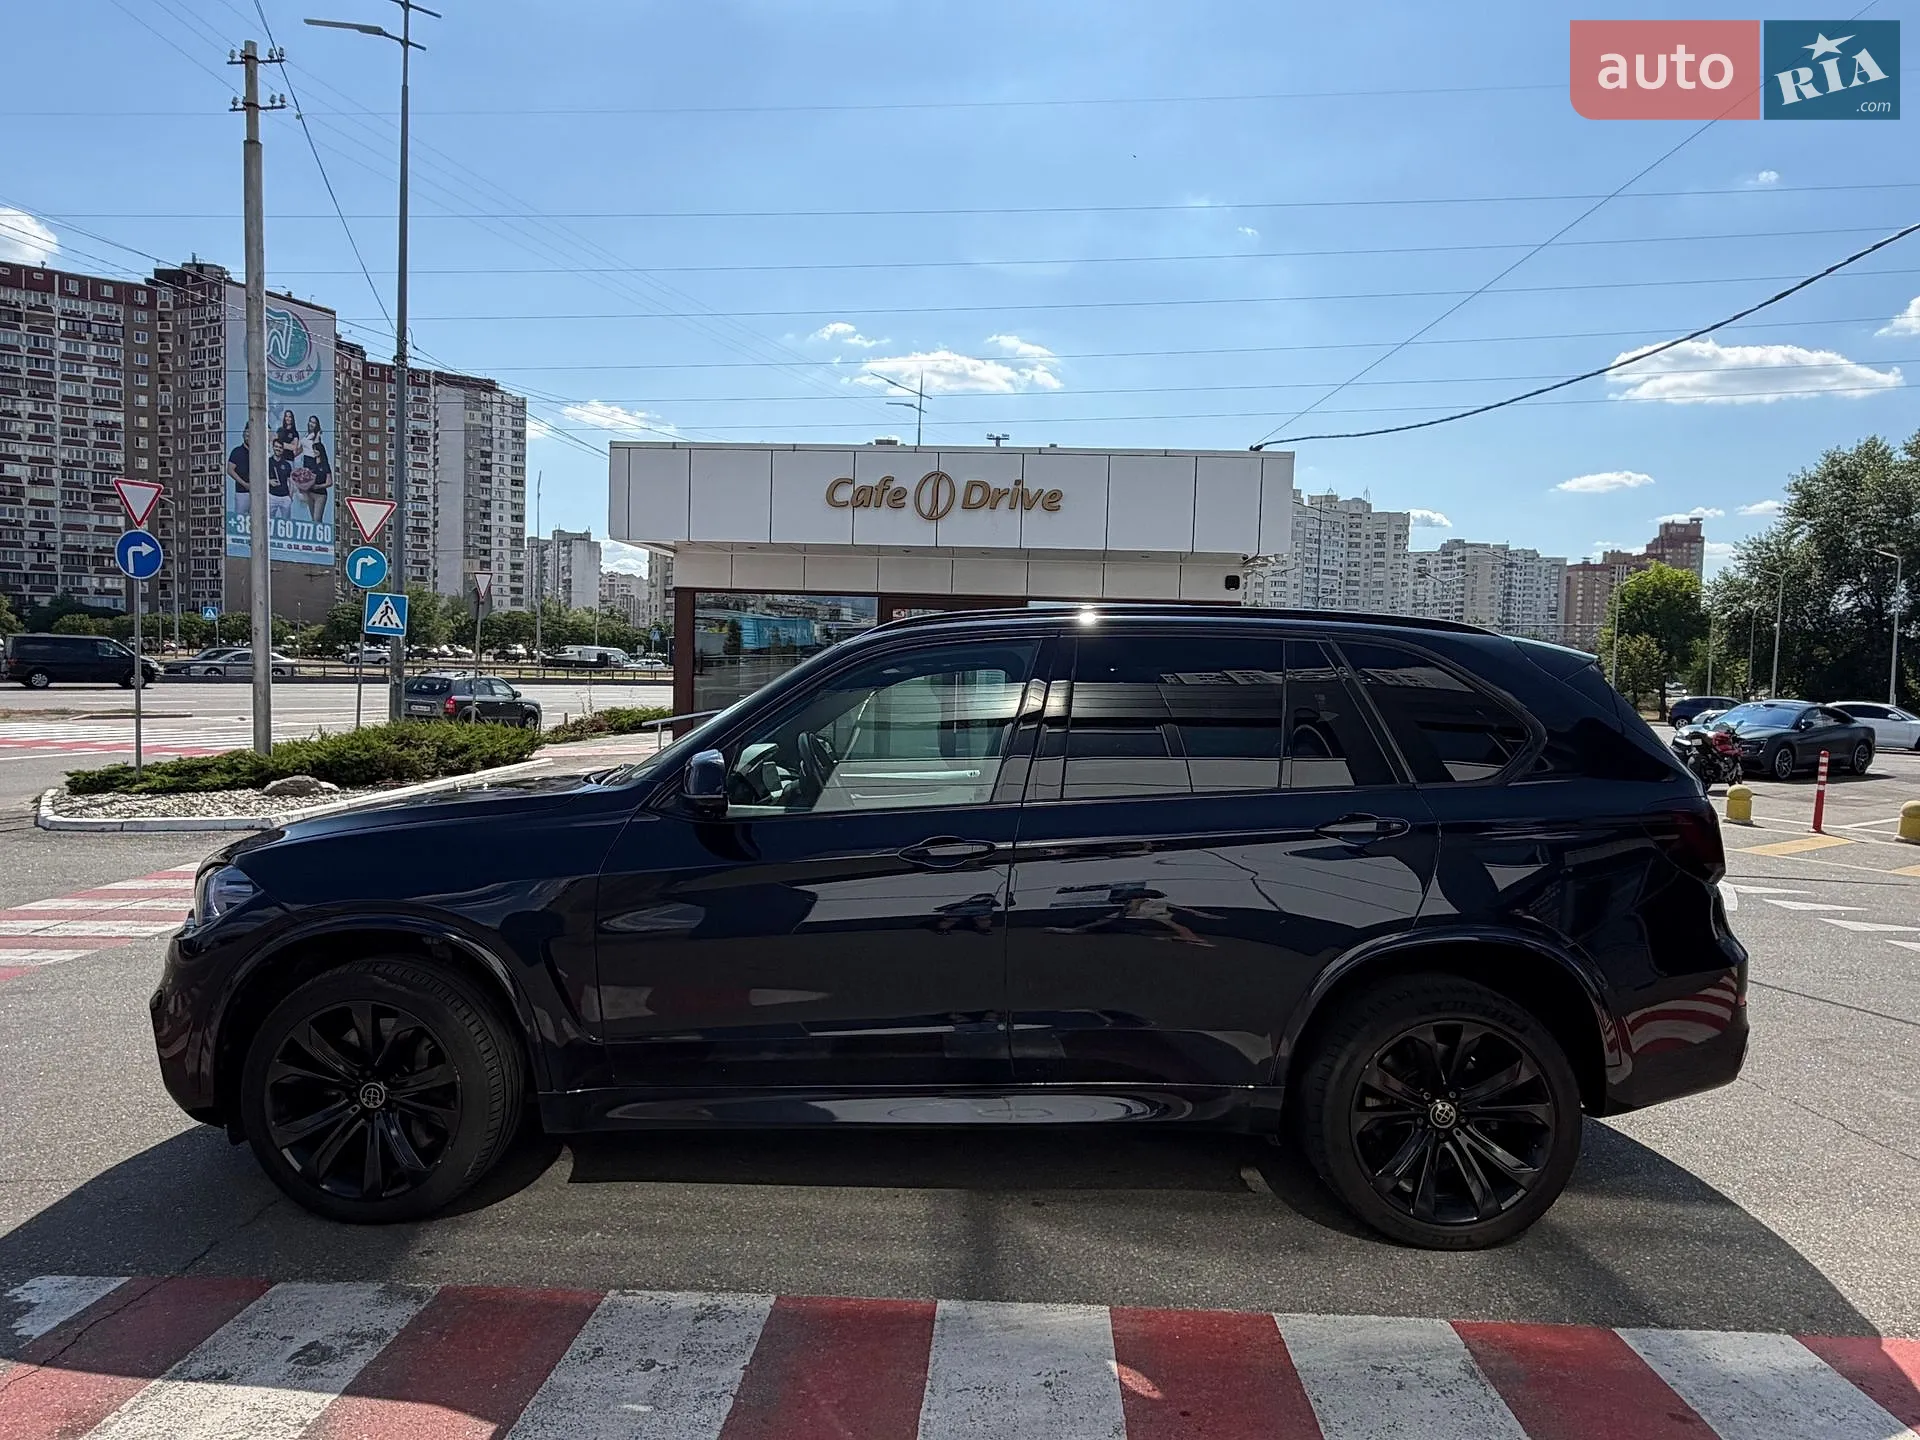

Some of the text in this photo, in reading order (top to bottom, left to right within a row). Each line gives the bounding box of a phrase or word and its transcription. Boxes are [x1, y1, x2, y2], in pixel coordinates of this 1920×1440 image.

[825, 476, 1064, 512] Cafe Drive
[277, 520, 294, 539] 60
[296, 521, 314, 540] 777
[316, 523, 331, 543] 60
